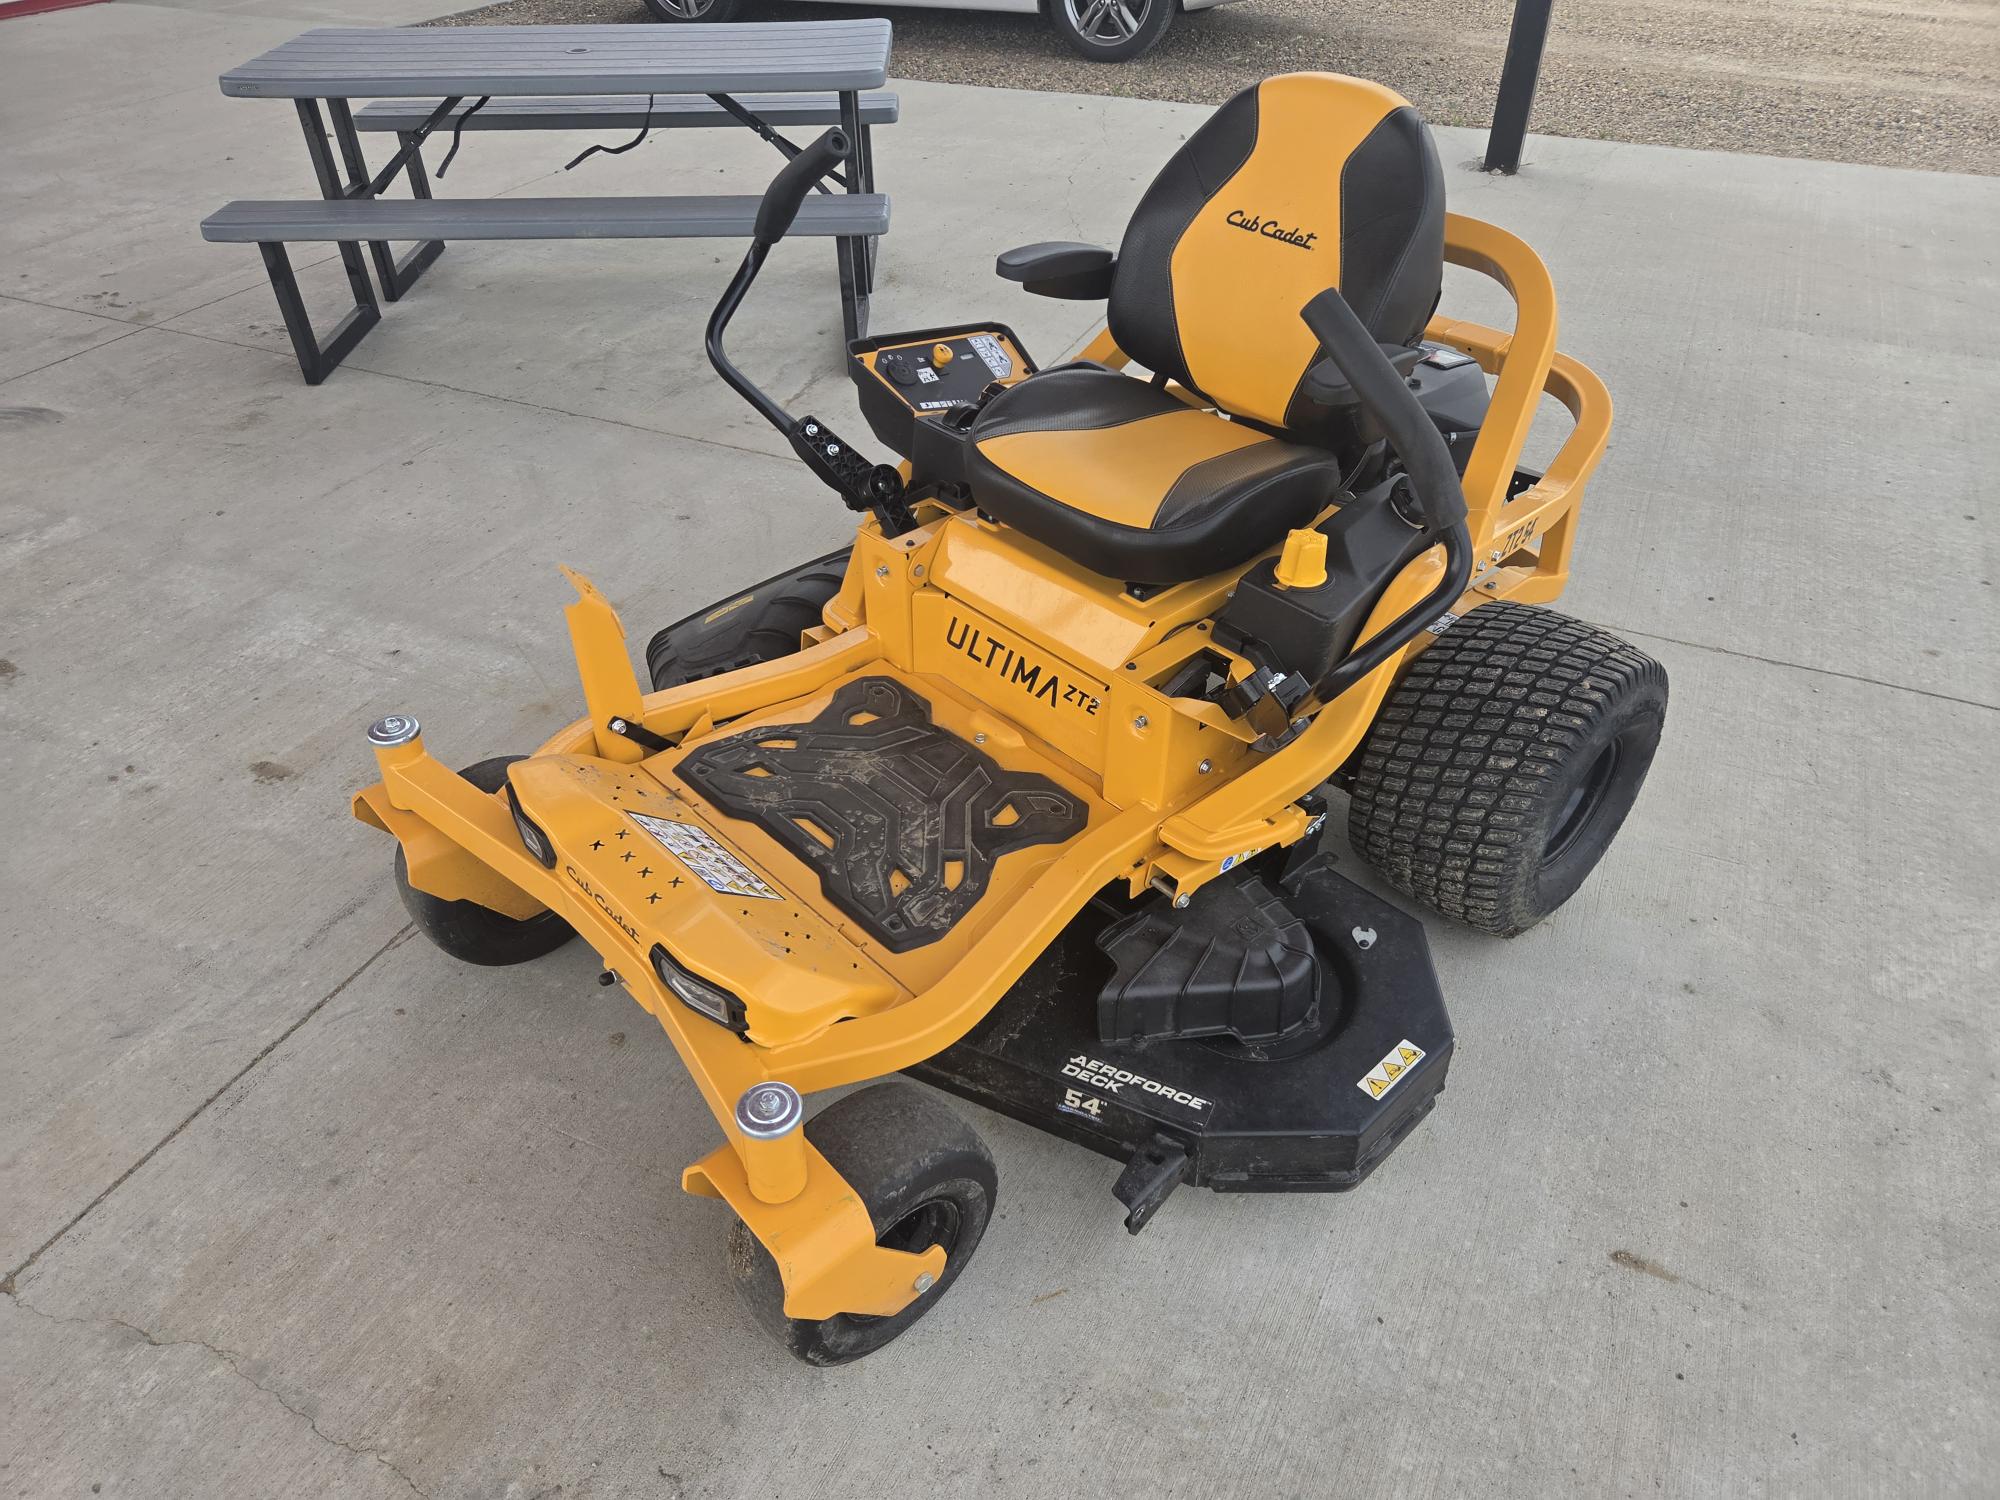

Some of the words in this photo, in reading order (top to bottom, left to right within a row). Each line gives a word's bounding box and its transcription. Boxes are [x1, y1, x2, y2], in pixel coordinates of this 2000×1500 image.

[1226, 209, 1260, 233] Cub
[1260, 220, 1318, 250] Cadet
[1501, 525, 1525, 557] ZT2
[1521, 516, 1540, 545] 54
[946, 616, 1060, 709] ULTIMA
[1062, 683, 1100, 716] ZT2
[565, 865, 593, 897] Cub
[593, 893, 641, 944] Cadet
[1061, 1063, 1125, 1094] DECK
[1069, 1055, 1209, 1110] AEROFORCE
[1063, 1088, 1108, 1116] 54"
